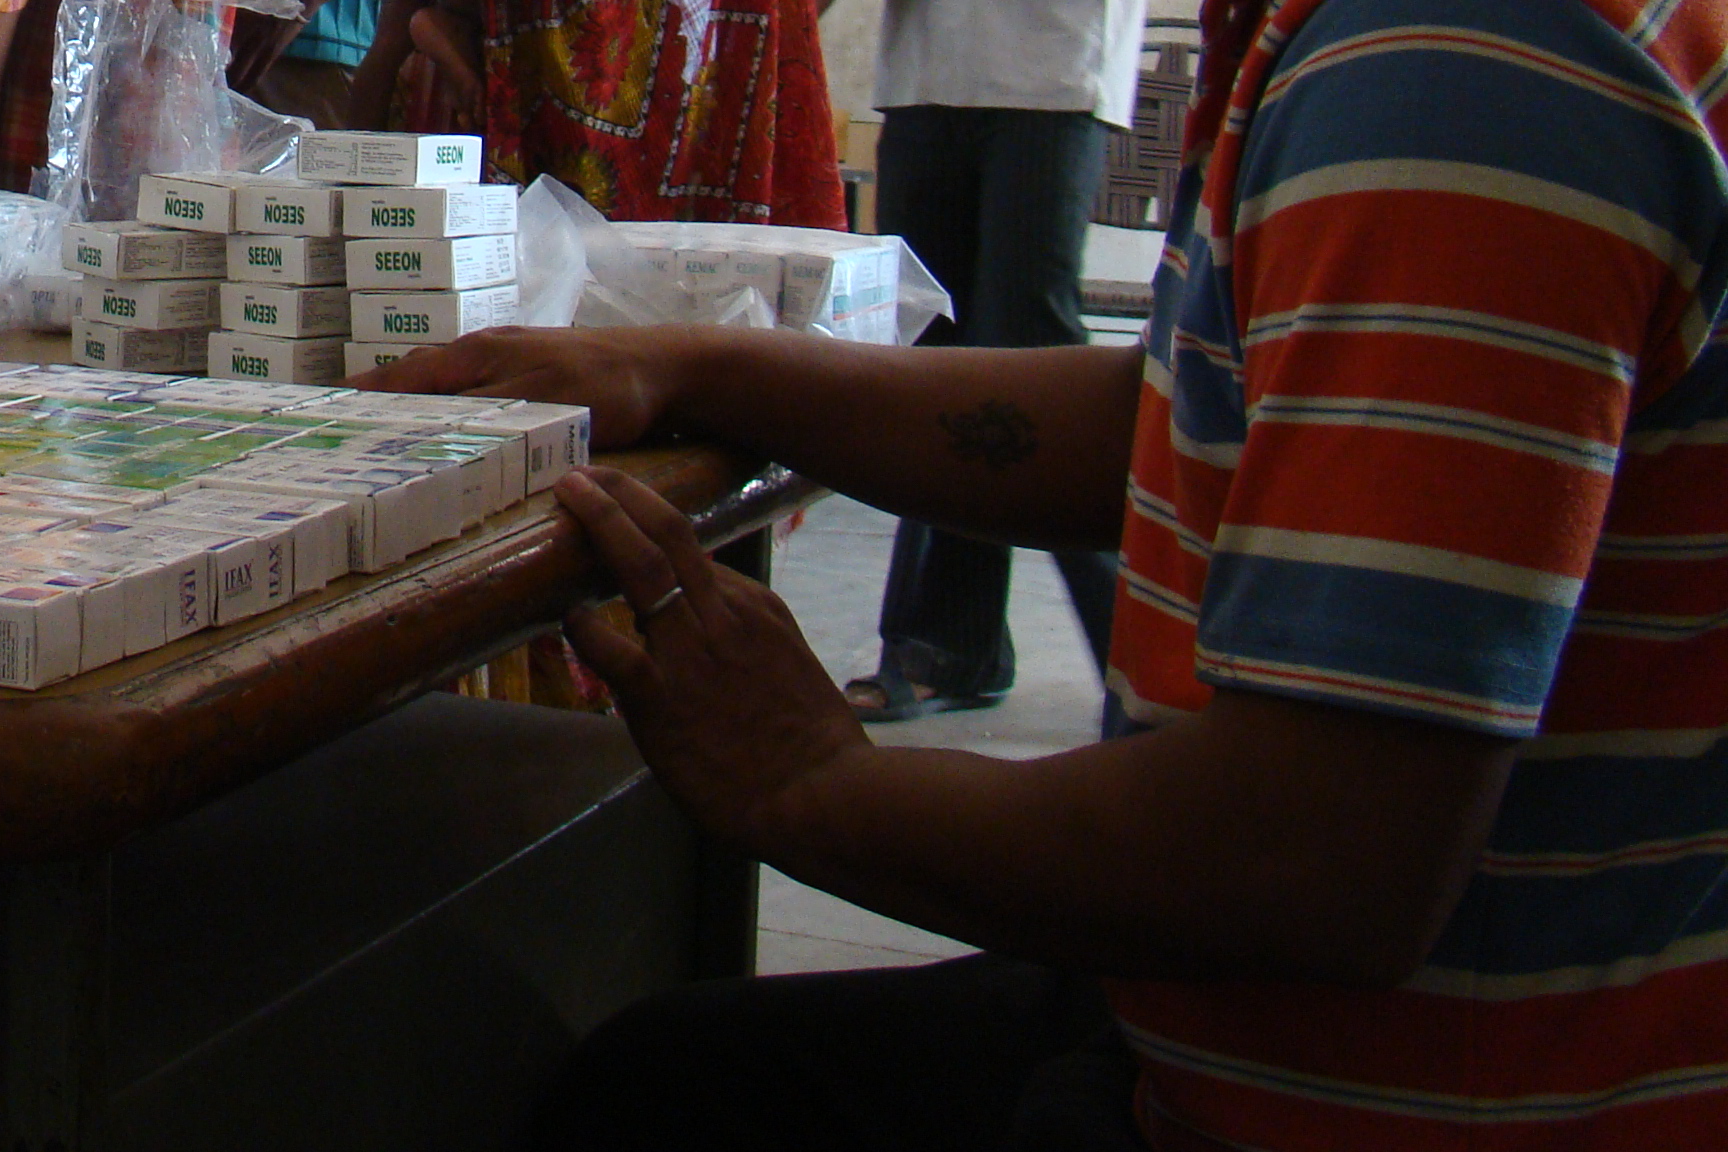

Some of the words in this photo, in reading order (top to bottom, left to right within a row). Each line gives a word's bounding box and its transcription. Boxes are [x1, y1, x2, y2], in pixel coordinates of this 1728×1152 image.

[435, 146, 464, 164] SEEON
[164, 197, 204, 221] SEEON
[264, 204, 305, 225] SEEON
[371, 207, 416, 228] SEEON
[77, 244, 102, 268] SEEON
[248, 245, 282, 267] SEEON
[375, 251, 422, 272] SEEON
[102, 294, 137, 318] SEEON
[244, 303, 278, 324] SEEON
[384, 313, 429, 334] SEEON
[85, 339, 106, 362] SEEON
[232, 354, 269, 378] SEEON
[225, 563, 253, 591] IFAX
[269, 544, 281, 598] IFAX
[184, 569, 197, 624] IFAX
